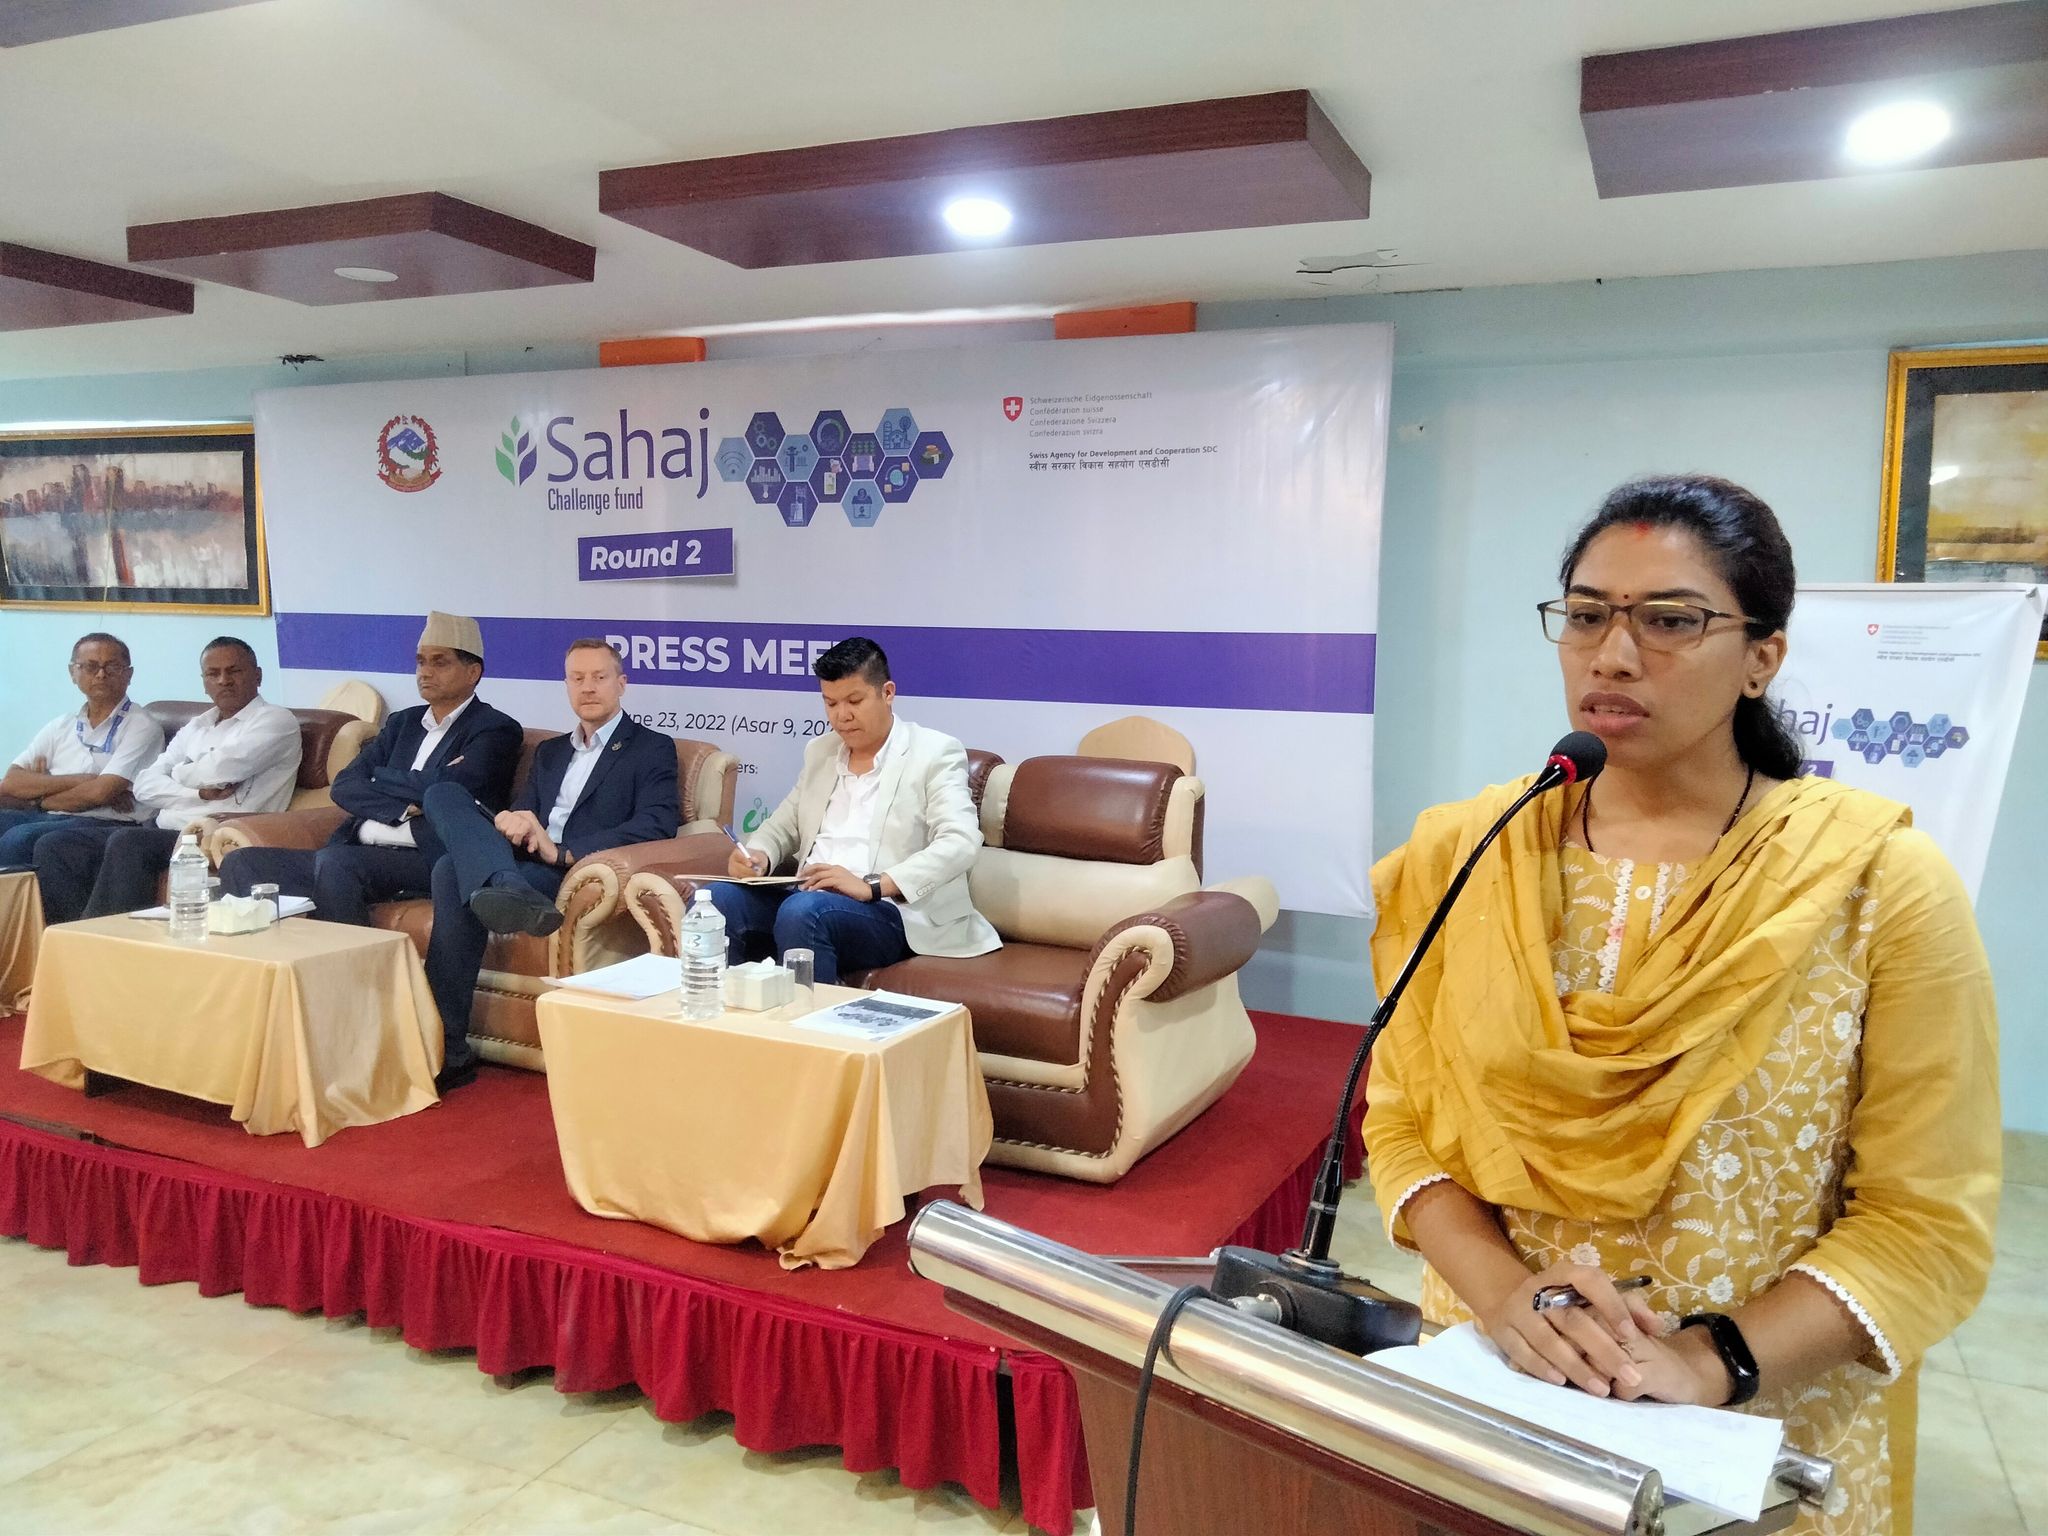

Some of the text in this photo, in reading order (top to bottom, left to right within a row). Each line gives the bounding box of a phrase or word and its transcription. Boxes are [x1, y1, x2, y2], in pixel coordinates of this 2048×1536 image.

[1030, 392, 1153, 404] Schweizerische Eidgenossenschaft
[1030, 416, 1117, 426] Confederazione Svizzera
[546, 408, 710, 499] Sahaj
[1029, 451, 1048, 459] Swiss
[1050, 451, 1075, 459] Agency
[1089, 449, 1137, 457] Development
[1139, 448, 1153, 456] and
[1155, 446, 1200, 456] Cooperation
[1202, 445, 1218, 453] SDC
[1051, 462, 1076, 470] सरकार
[1079, 459, 1104, 470] विकास
[1108, 458, 1135, 469] सहयोग
[1138, 456, 1170, 469] एसडीसी
[548, 486, 643, 516] Challenge fund
[590, 539, 702, 571] Round 2
[743, 638, 841, 676] MEE
[657, 711, 680, 731] 23,
[685, 713, 726, 731] 2022
[731, 715, 778, 736] (Asar
[783, 718, 797, 738] 9,
